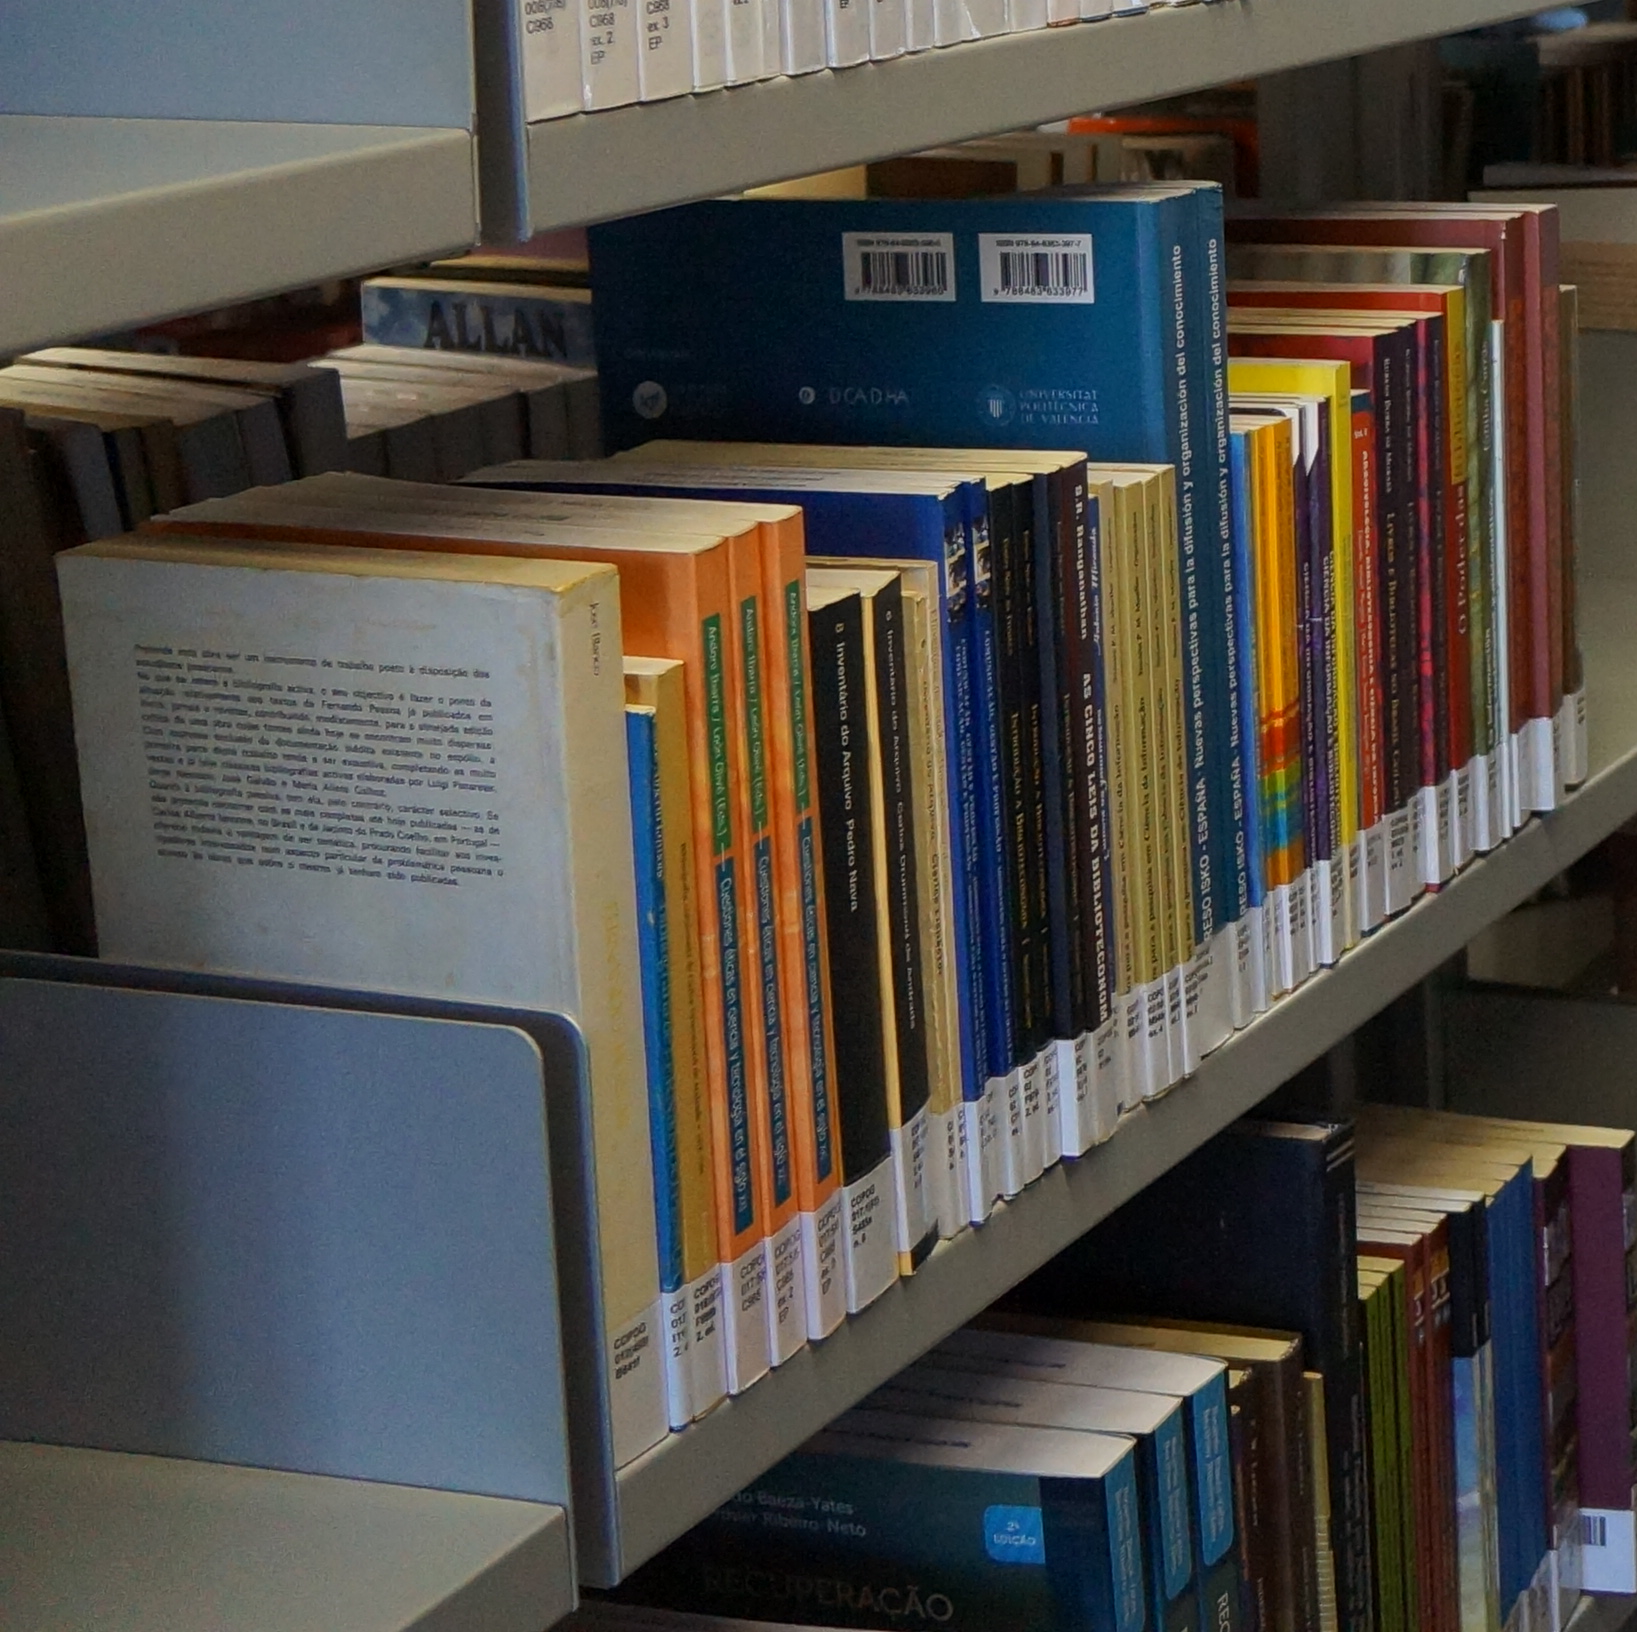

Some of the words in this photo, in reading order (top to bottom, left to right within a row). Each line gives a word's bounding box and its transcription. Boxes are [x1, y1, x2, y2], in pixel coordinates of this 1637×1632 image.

[1171, 245, 1185, 350] conocimiento
[1205, 239, 1222, 340] conocimiento
[1173, 351, 1187, 376] del
[1209, 342, 1223, 366] del
[1175, 378, 1192, 477] organización
[1212, 367, 1228, 464] organización
[1180, 493, 1195, 555] difusión
[1216, 479, 1231, 540] difusión
[1075, 524, 1090, 641] Ranganathan
[1184, 576, 1199, 611] para
[1456, 532, 1467, 607] Poder
[1185, 612, 1204, 709] perspectivas
[1222, 595, 1239, 688] perspectivas
[836, 641, 850, 720] Inventário
[1082, 672, 1093, 699] AS
[841, 724, 851, 746] do
[1084, 704, 1097, 767] CINCO
[1191, 711, 1206, 769] Nuevas
[842, 750, 855, 810] Arquivo
[1086, 772, 1098, 819] LEIS
[1193, 776, 1209, 842] ESPAÑA
[844, 818, 858, 865] Pedro
[1089, 823, 1100, 854] DA
[719, 876, 736, 947] Cuestiones
[757, 855, 774, 924] Cuestiones
[848, 869, 860, 912] Nava
